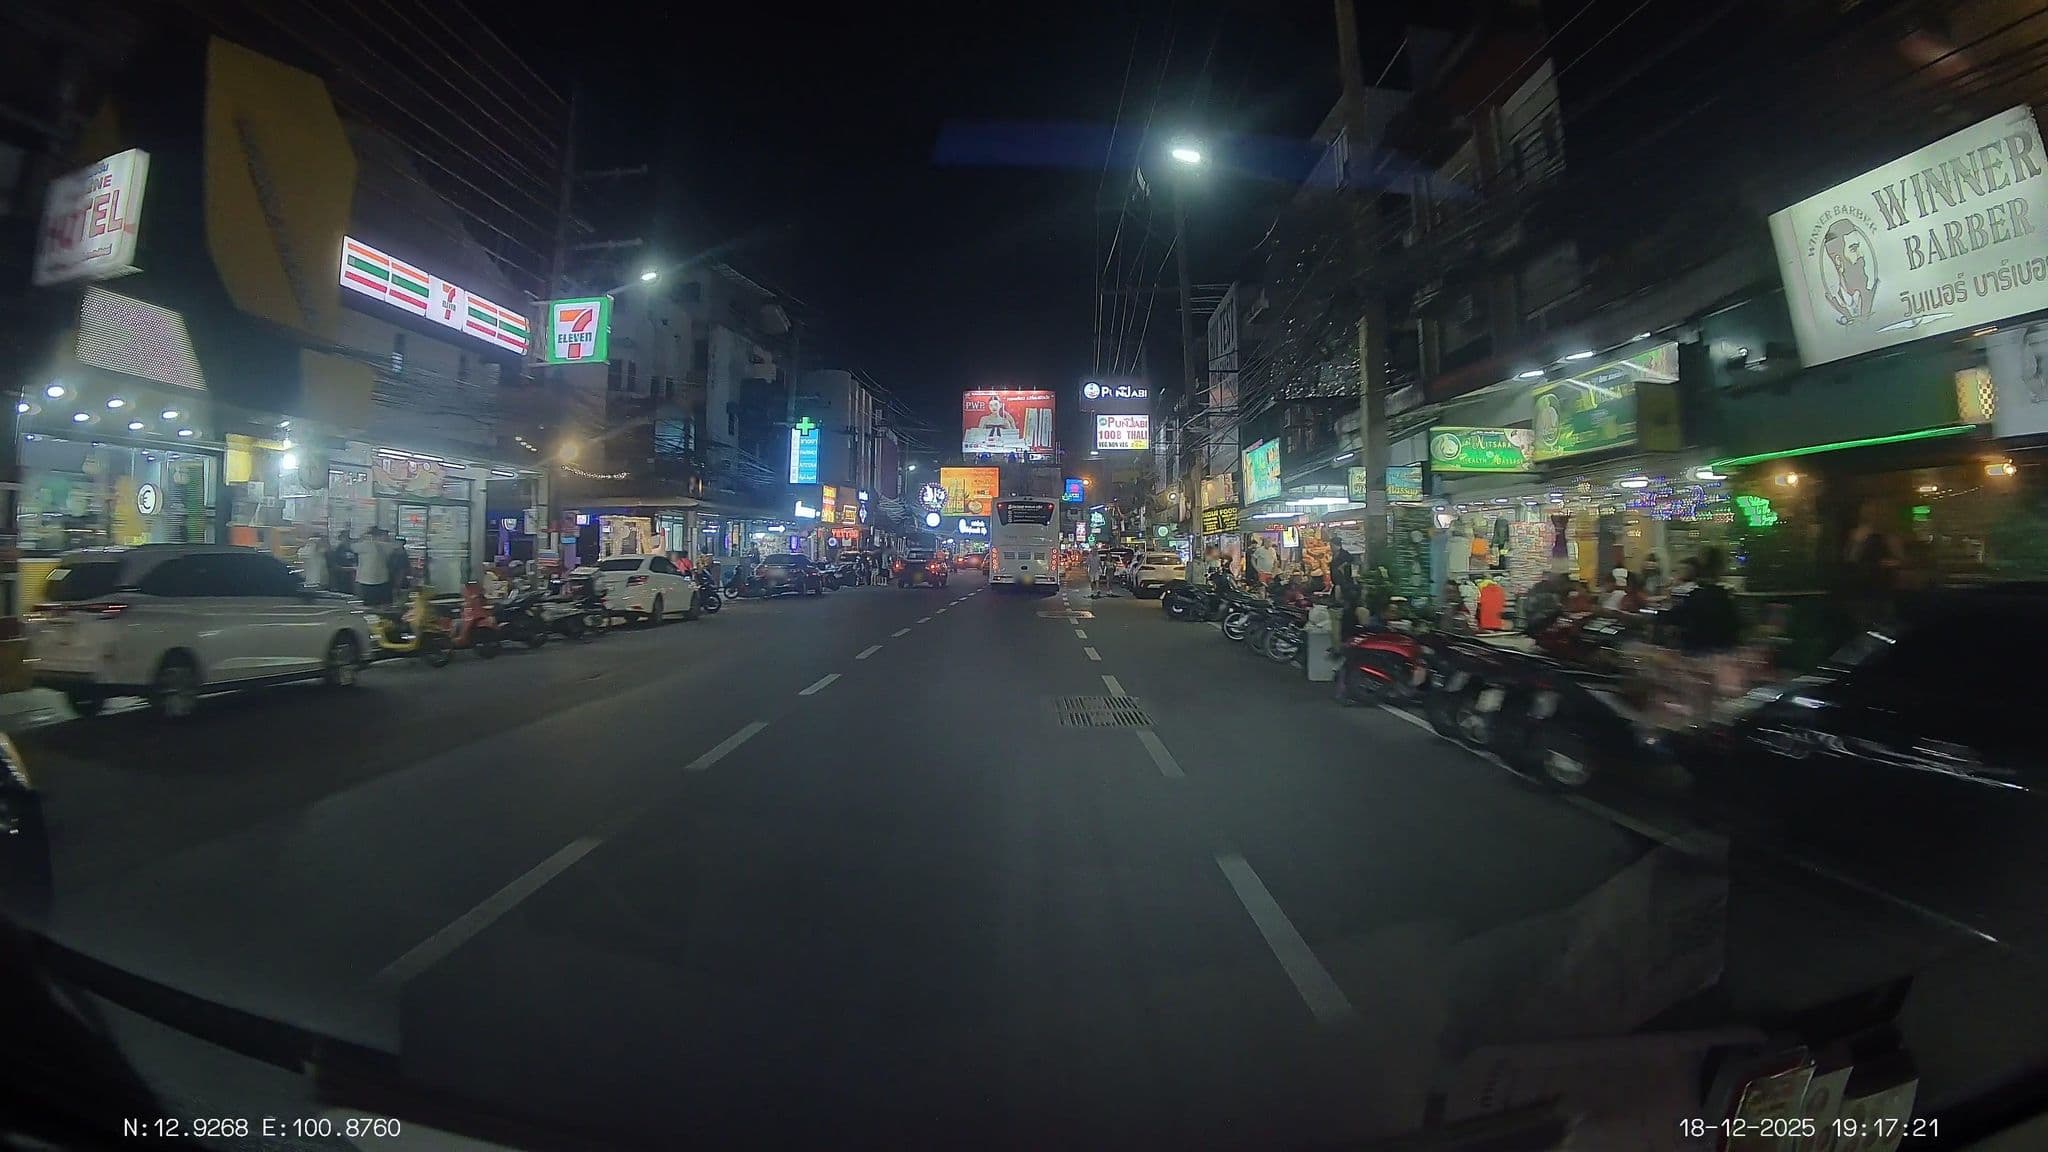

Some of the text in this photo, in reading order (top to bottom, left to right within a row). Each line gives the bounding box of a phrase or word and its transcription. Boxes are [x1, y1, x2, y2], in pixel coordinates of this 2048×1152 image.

[1871, 130, 2042, 231] WINNER
[1903, 197, 2036, 271] BARBER
[1973, 258, 2048, 298] บาร์เบอ
[1127, 430, 1148, 440] THALI
